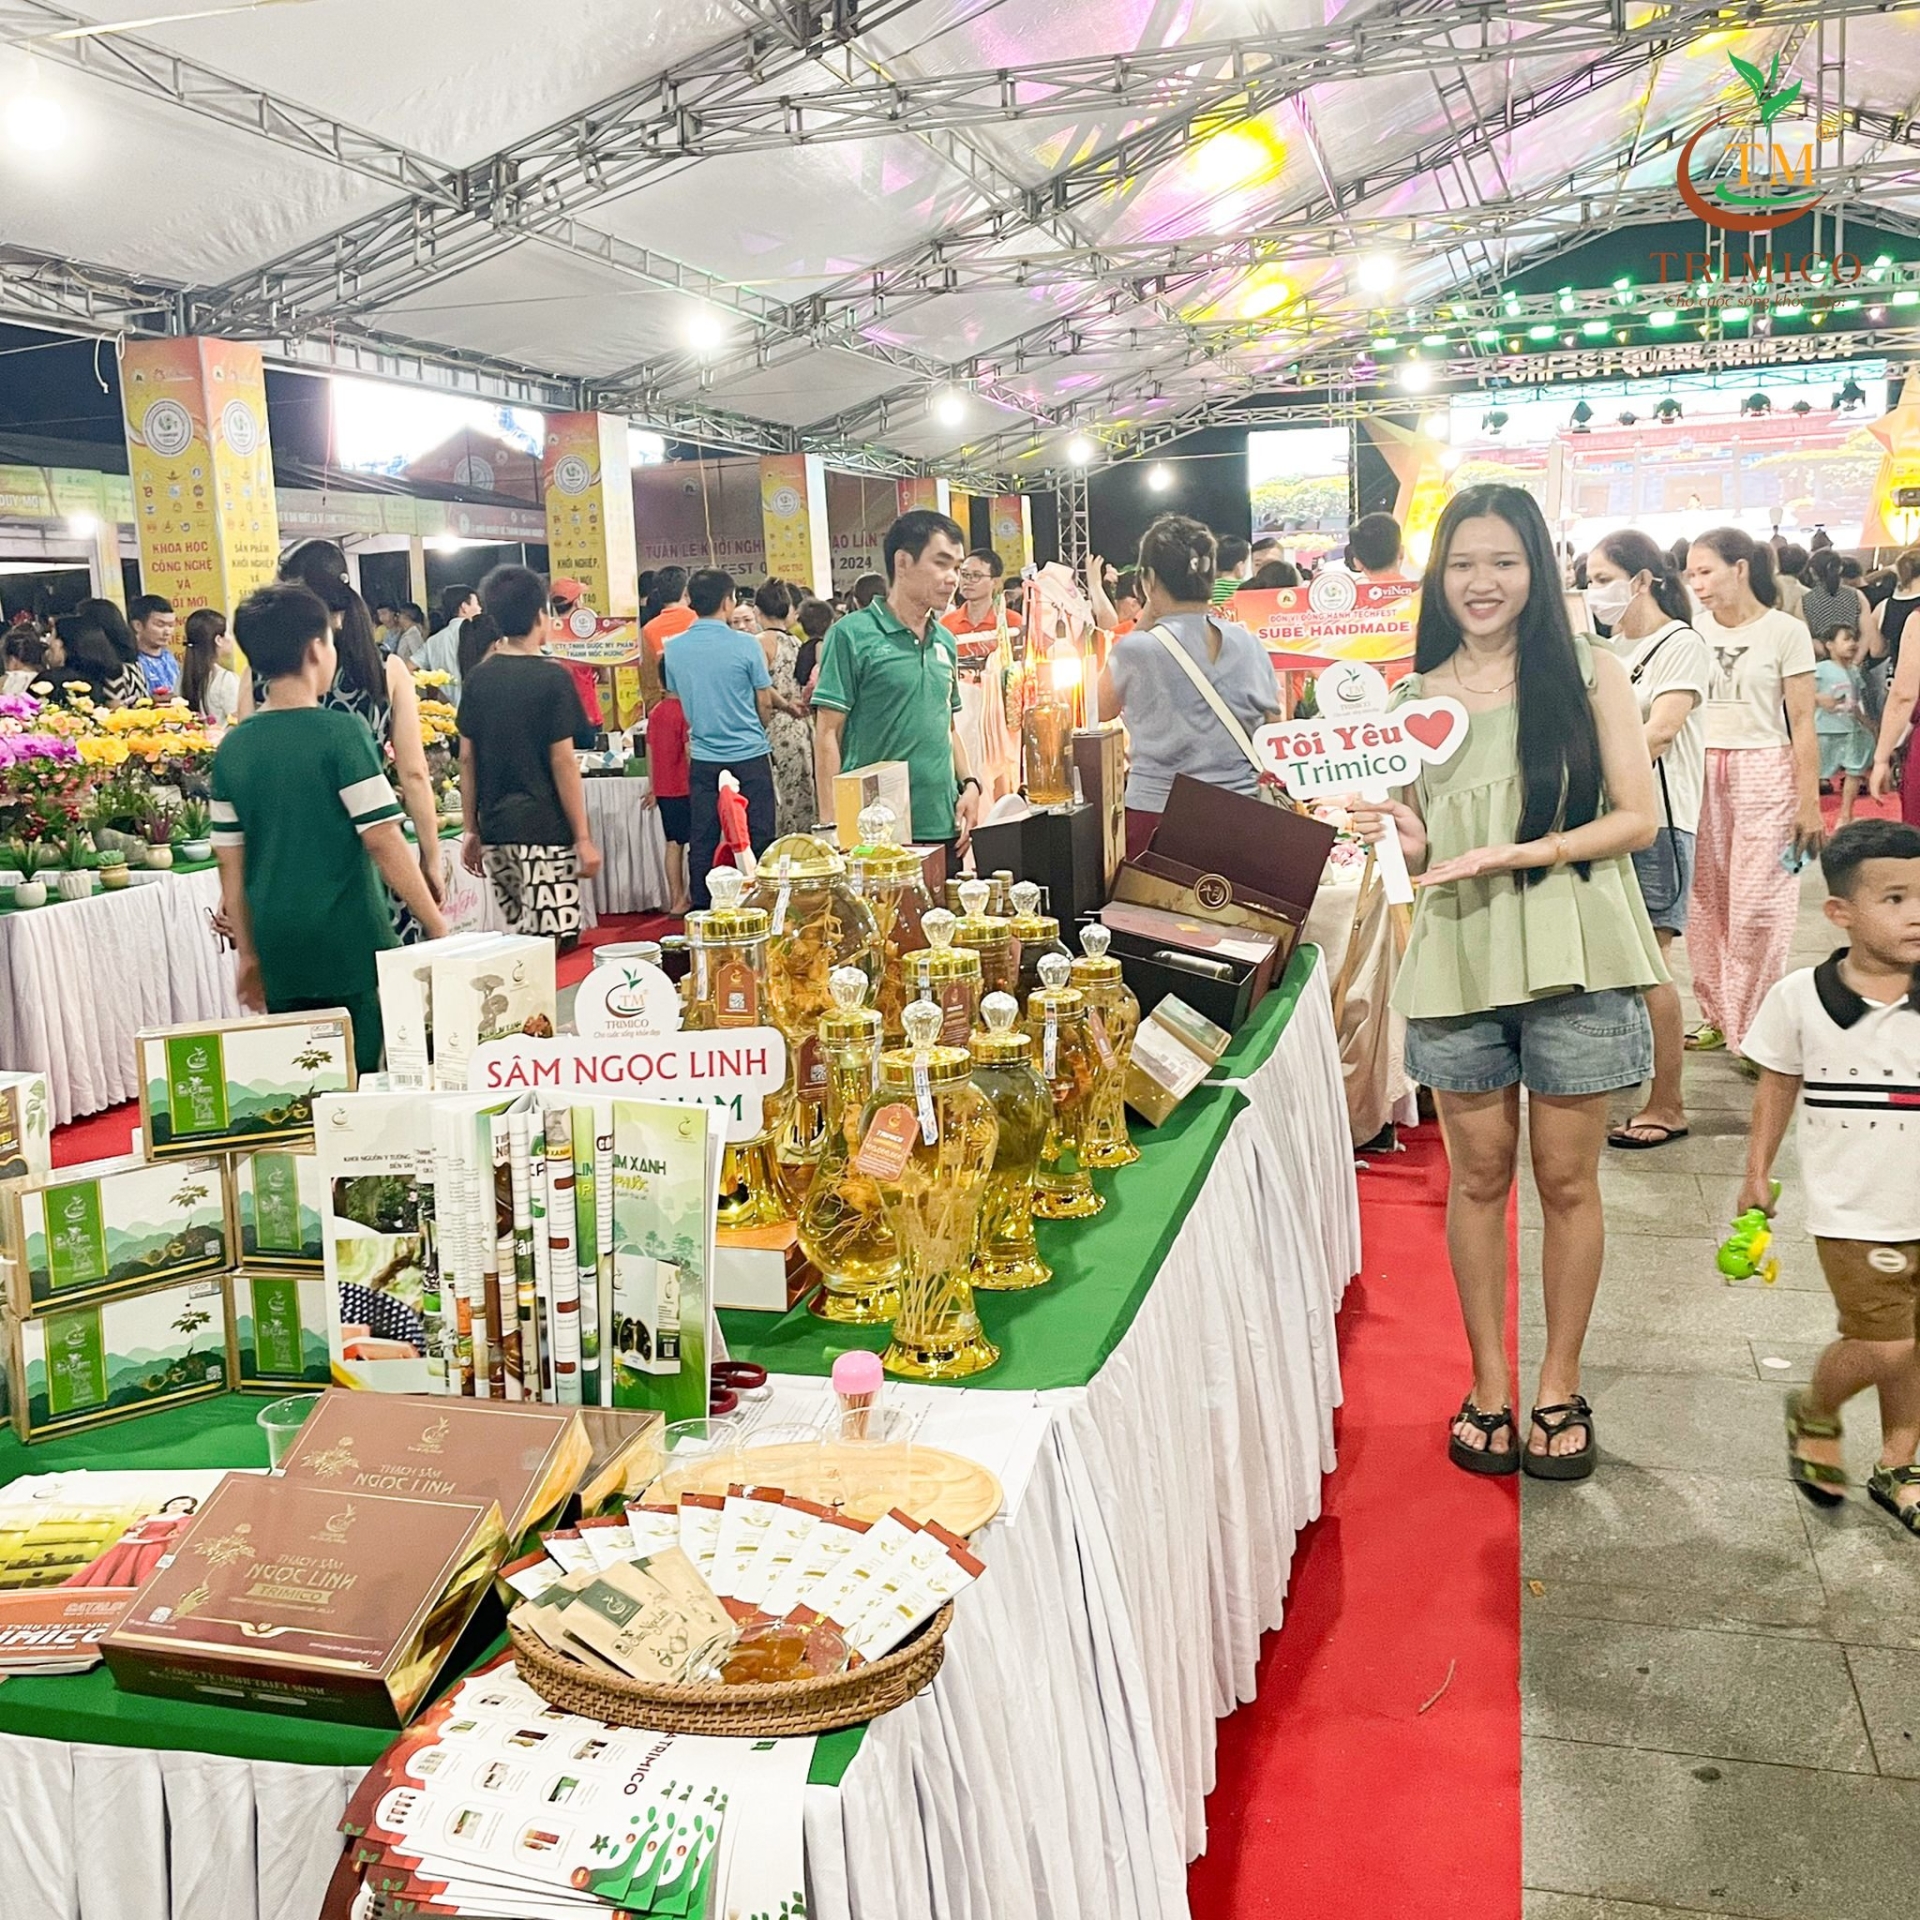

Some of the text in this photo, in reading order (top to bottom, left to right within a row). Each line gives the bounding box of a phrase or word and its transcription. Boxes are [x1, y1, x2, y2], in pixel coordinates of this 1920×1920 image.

[152, 542, 182, 554] KHOA
[840, 556, 872, 571] 2024
[1352, 608, 1397, 618] TECHFEST
[1310, 621, 1410, 636] HANDMADE
[1267, 722, 1403, 761] Tôi Yêu
[1288, 753, 1407, 786] Trimico
[605, 1019, 649, 1029] TRIMICO
[487, 1054, 561, 1088] SÂM
[574, 1051, 678, 1085] NGỌC
[690, 1048, 767, 1078] LINH
[630, 1156, 667, 1175] XANH
[244, 1563, 358, 1590] NGỌC LINH
[260, 1585, 323, 1601] TRIMICO
[624, 1741, 673, 1795] TRIMICO
